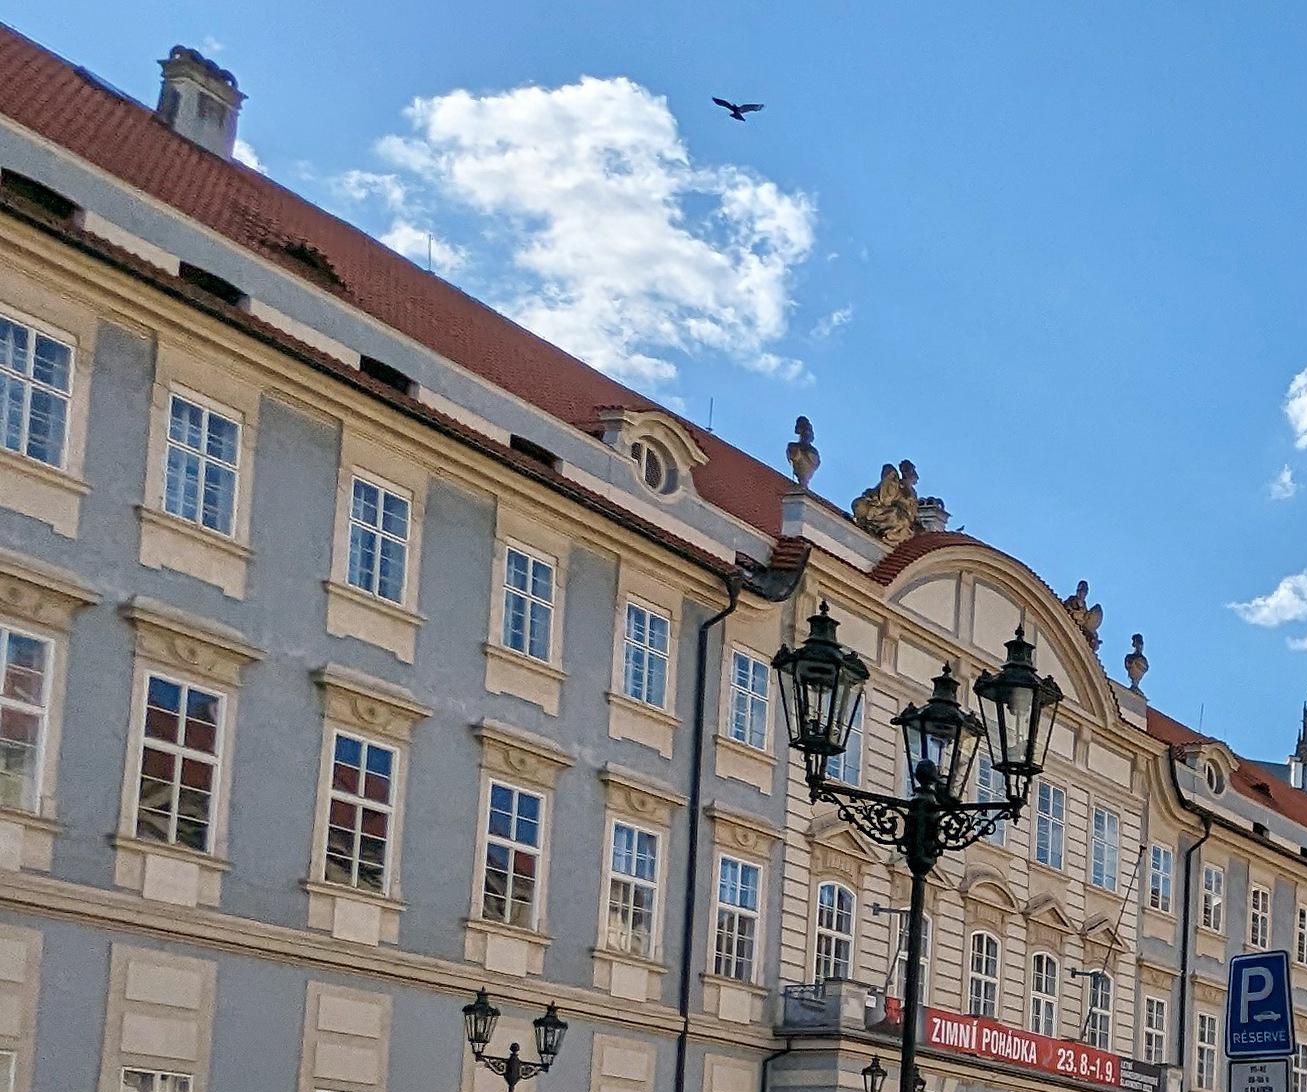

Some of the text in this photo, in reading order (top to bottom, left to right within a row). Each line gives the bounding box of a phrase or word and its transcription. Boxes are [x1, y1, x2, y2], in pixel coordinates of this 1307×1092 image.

[1240, 966, 1274, 1024] P
[932, 1017, 978, 1050] ZIMNÍ
[981, 1028, 1037, 1065] POHÁDKA
